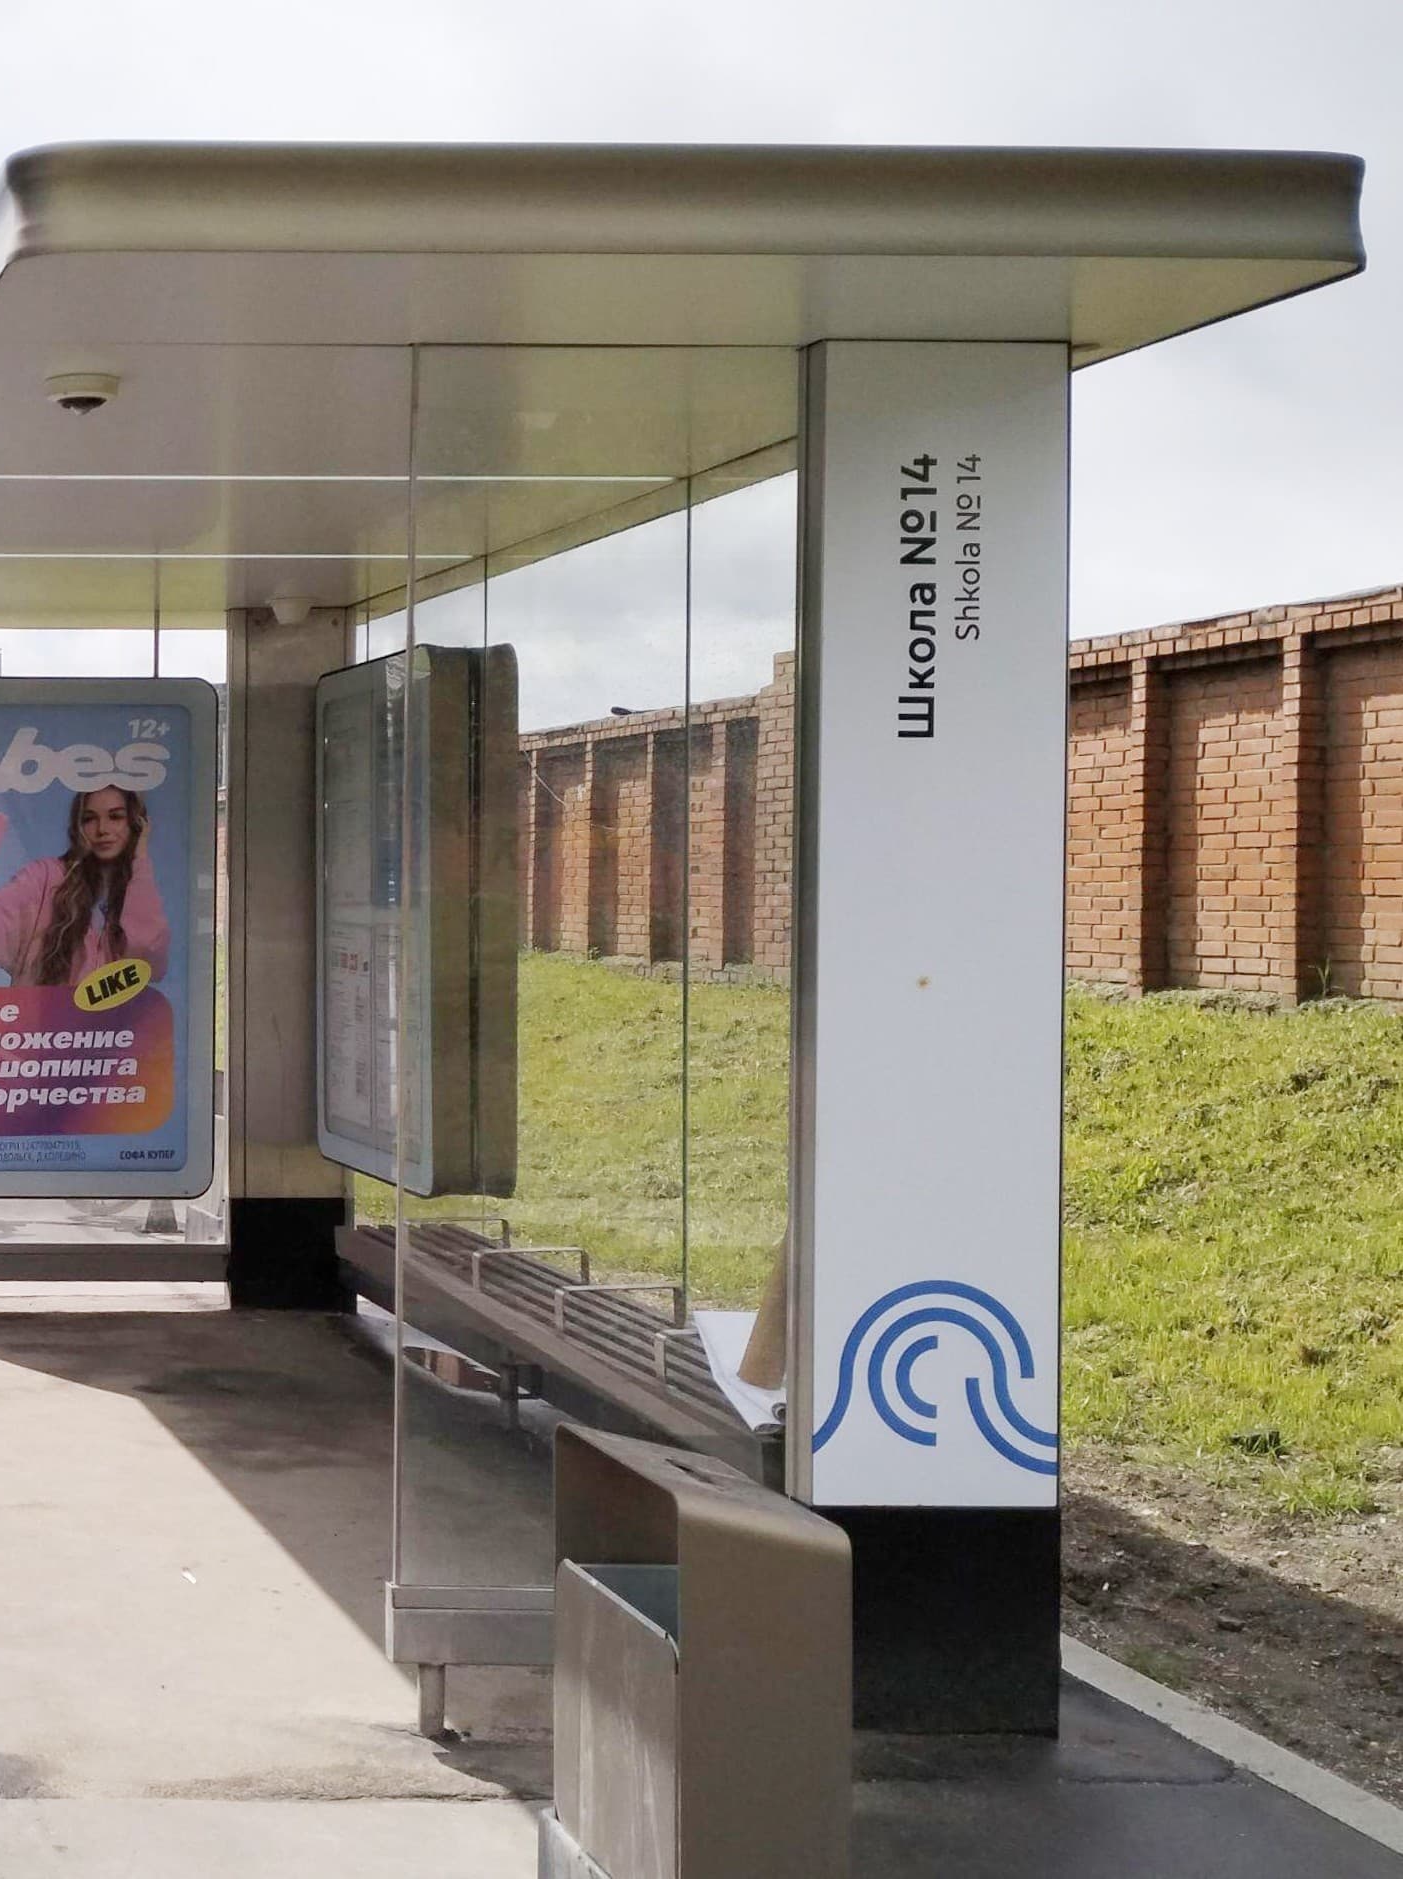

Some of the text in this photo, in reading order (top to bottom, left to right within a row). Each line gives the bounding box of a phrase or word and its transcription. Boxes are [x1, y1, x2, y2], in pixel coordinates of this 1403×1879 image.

[954, 542, 982, 641] Shkola
[897, 582, 938, 738] Школа
[128, 718, 171, 740] 12+
[85, 964, 142, 1006] LIKE
